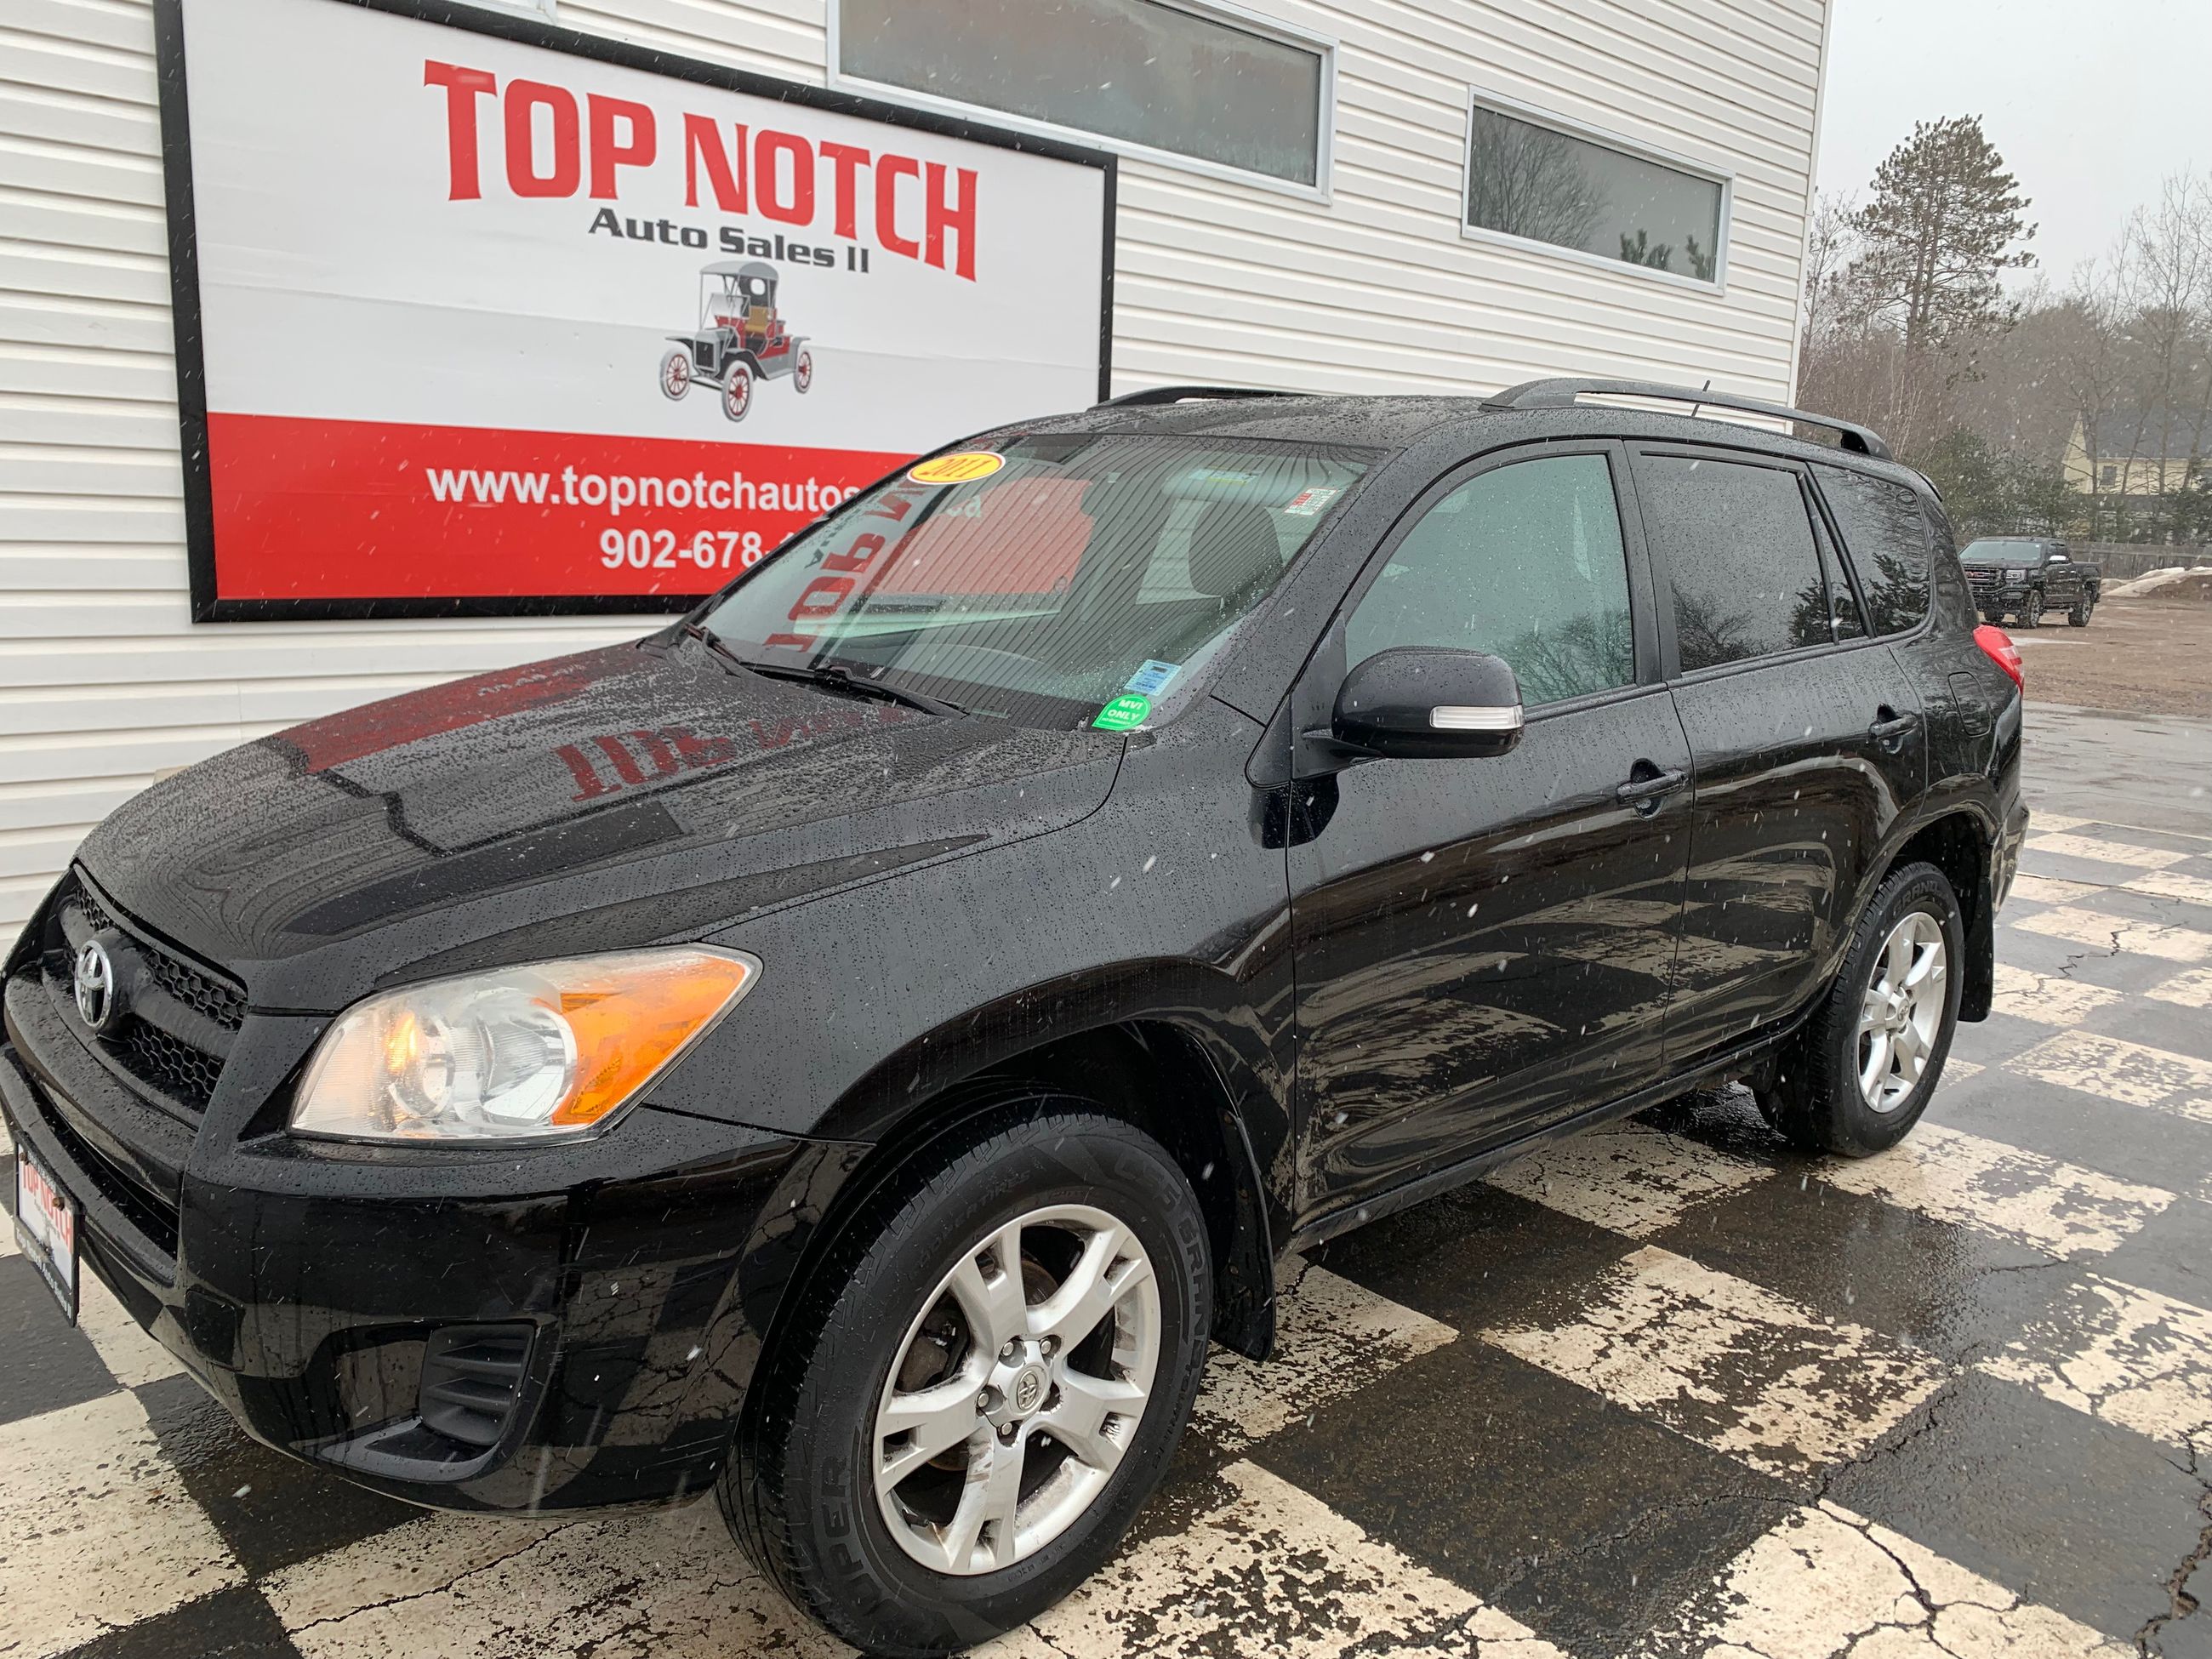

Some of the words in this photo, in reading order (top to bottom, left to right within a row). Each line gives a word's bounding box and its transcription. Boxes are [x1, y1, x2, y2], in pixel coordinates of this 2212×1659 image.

[423, 59, 657, 201] TOP
[682, 111, 978, 282] NOTCH
[588, 208, 708, 249] Auto
[719, 225, 835, 268] Sales
[847, 247, 869, 273] II
[599, 528, 795, 569] 902-678
[1107, 710, 1141, 721] ONLY
[1118, 699, 1143, 710] MVI
